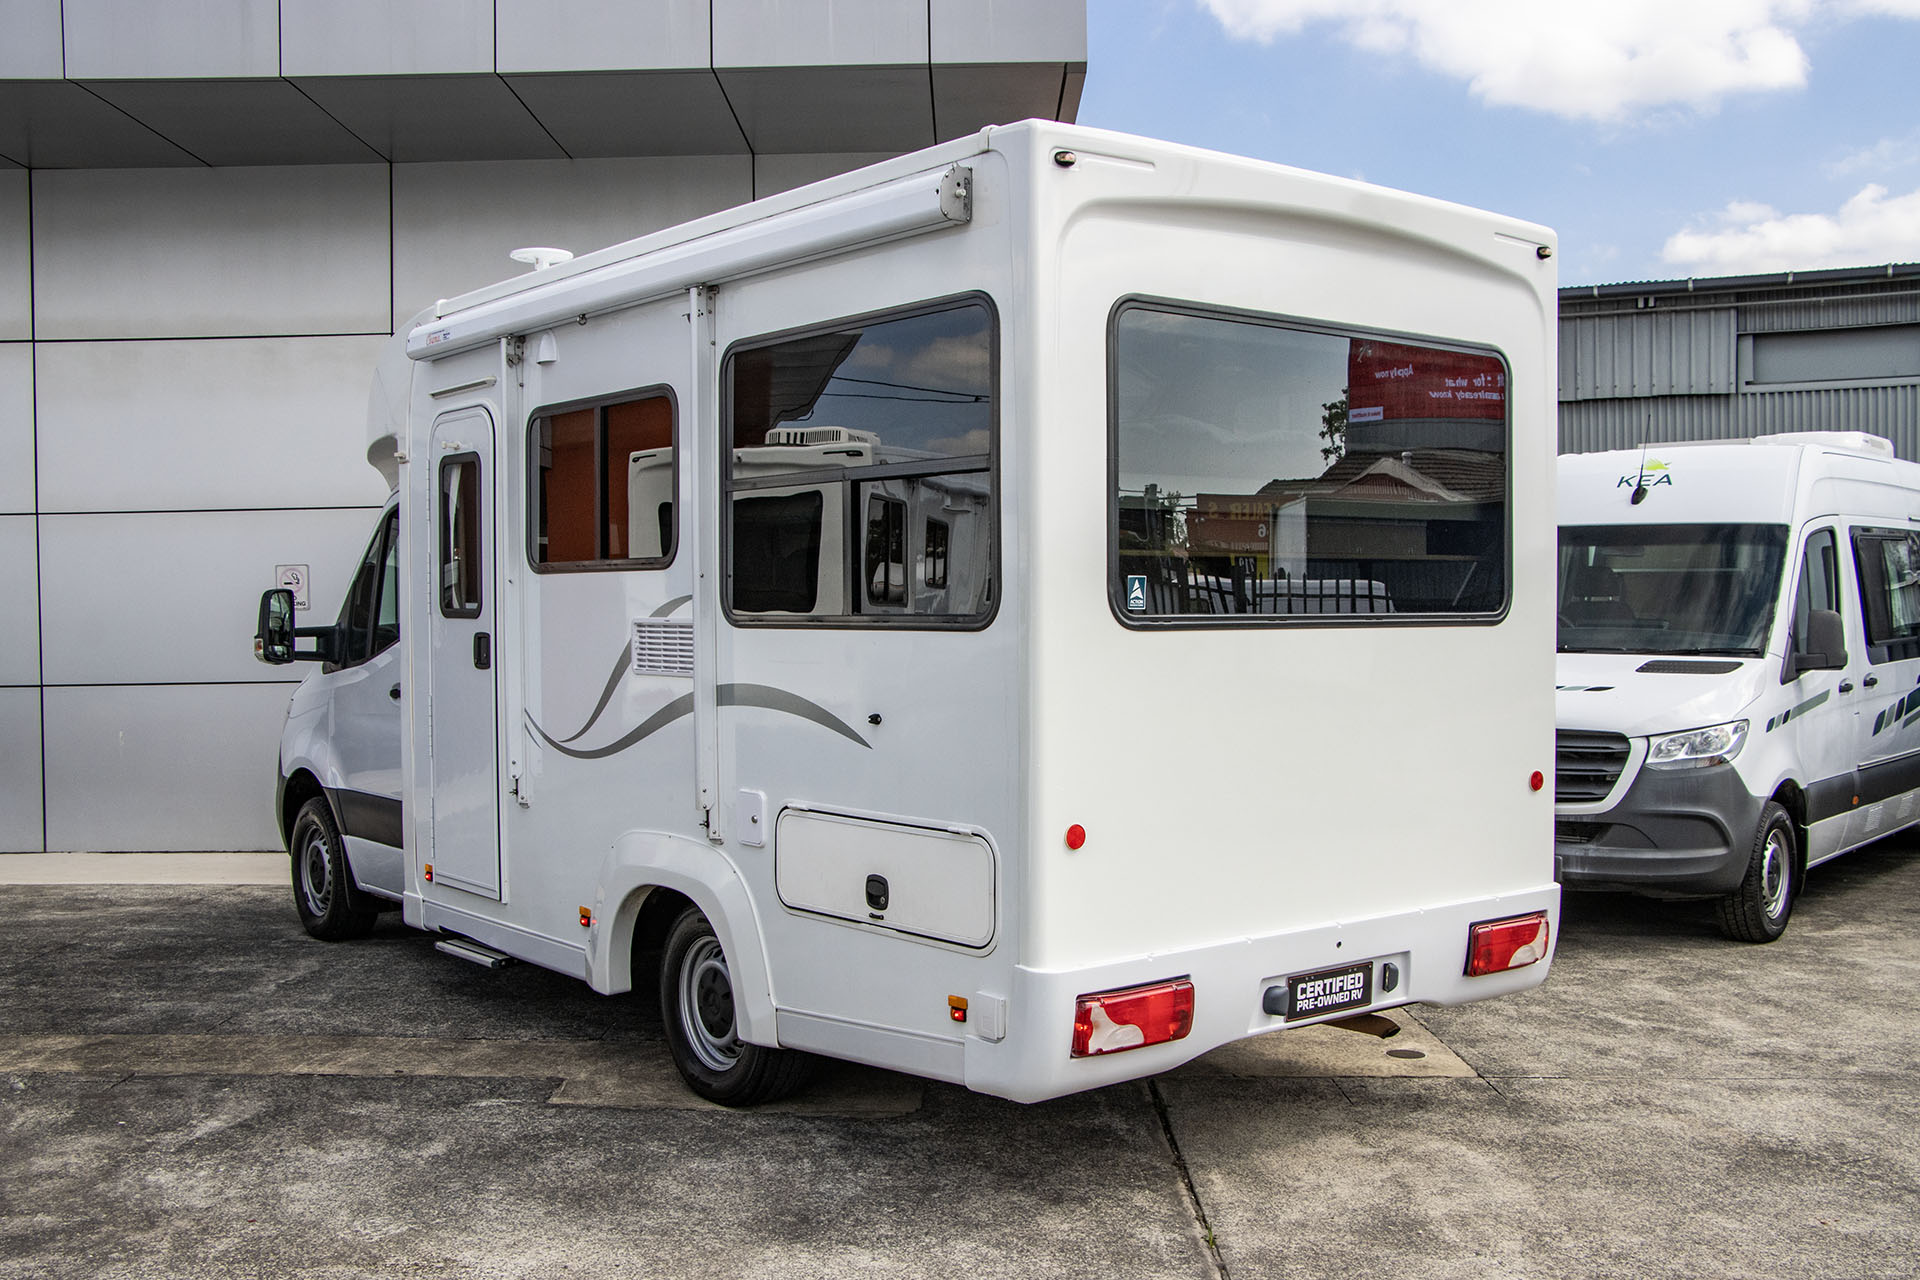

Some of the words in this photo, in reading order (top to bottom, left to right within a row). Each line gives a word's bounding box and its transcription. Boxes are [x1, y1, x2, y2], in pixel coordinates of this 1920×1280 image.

[1617, 474, 1672, 488] KEA
[1297, 972, 1364, 1000] CERTIFIED
[1296, 991, 1350, 1012] PRE-OWNED
[1351, 988, 1363, 1000] RV
